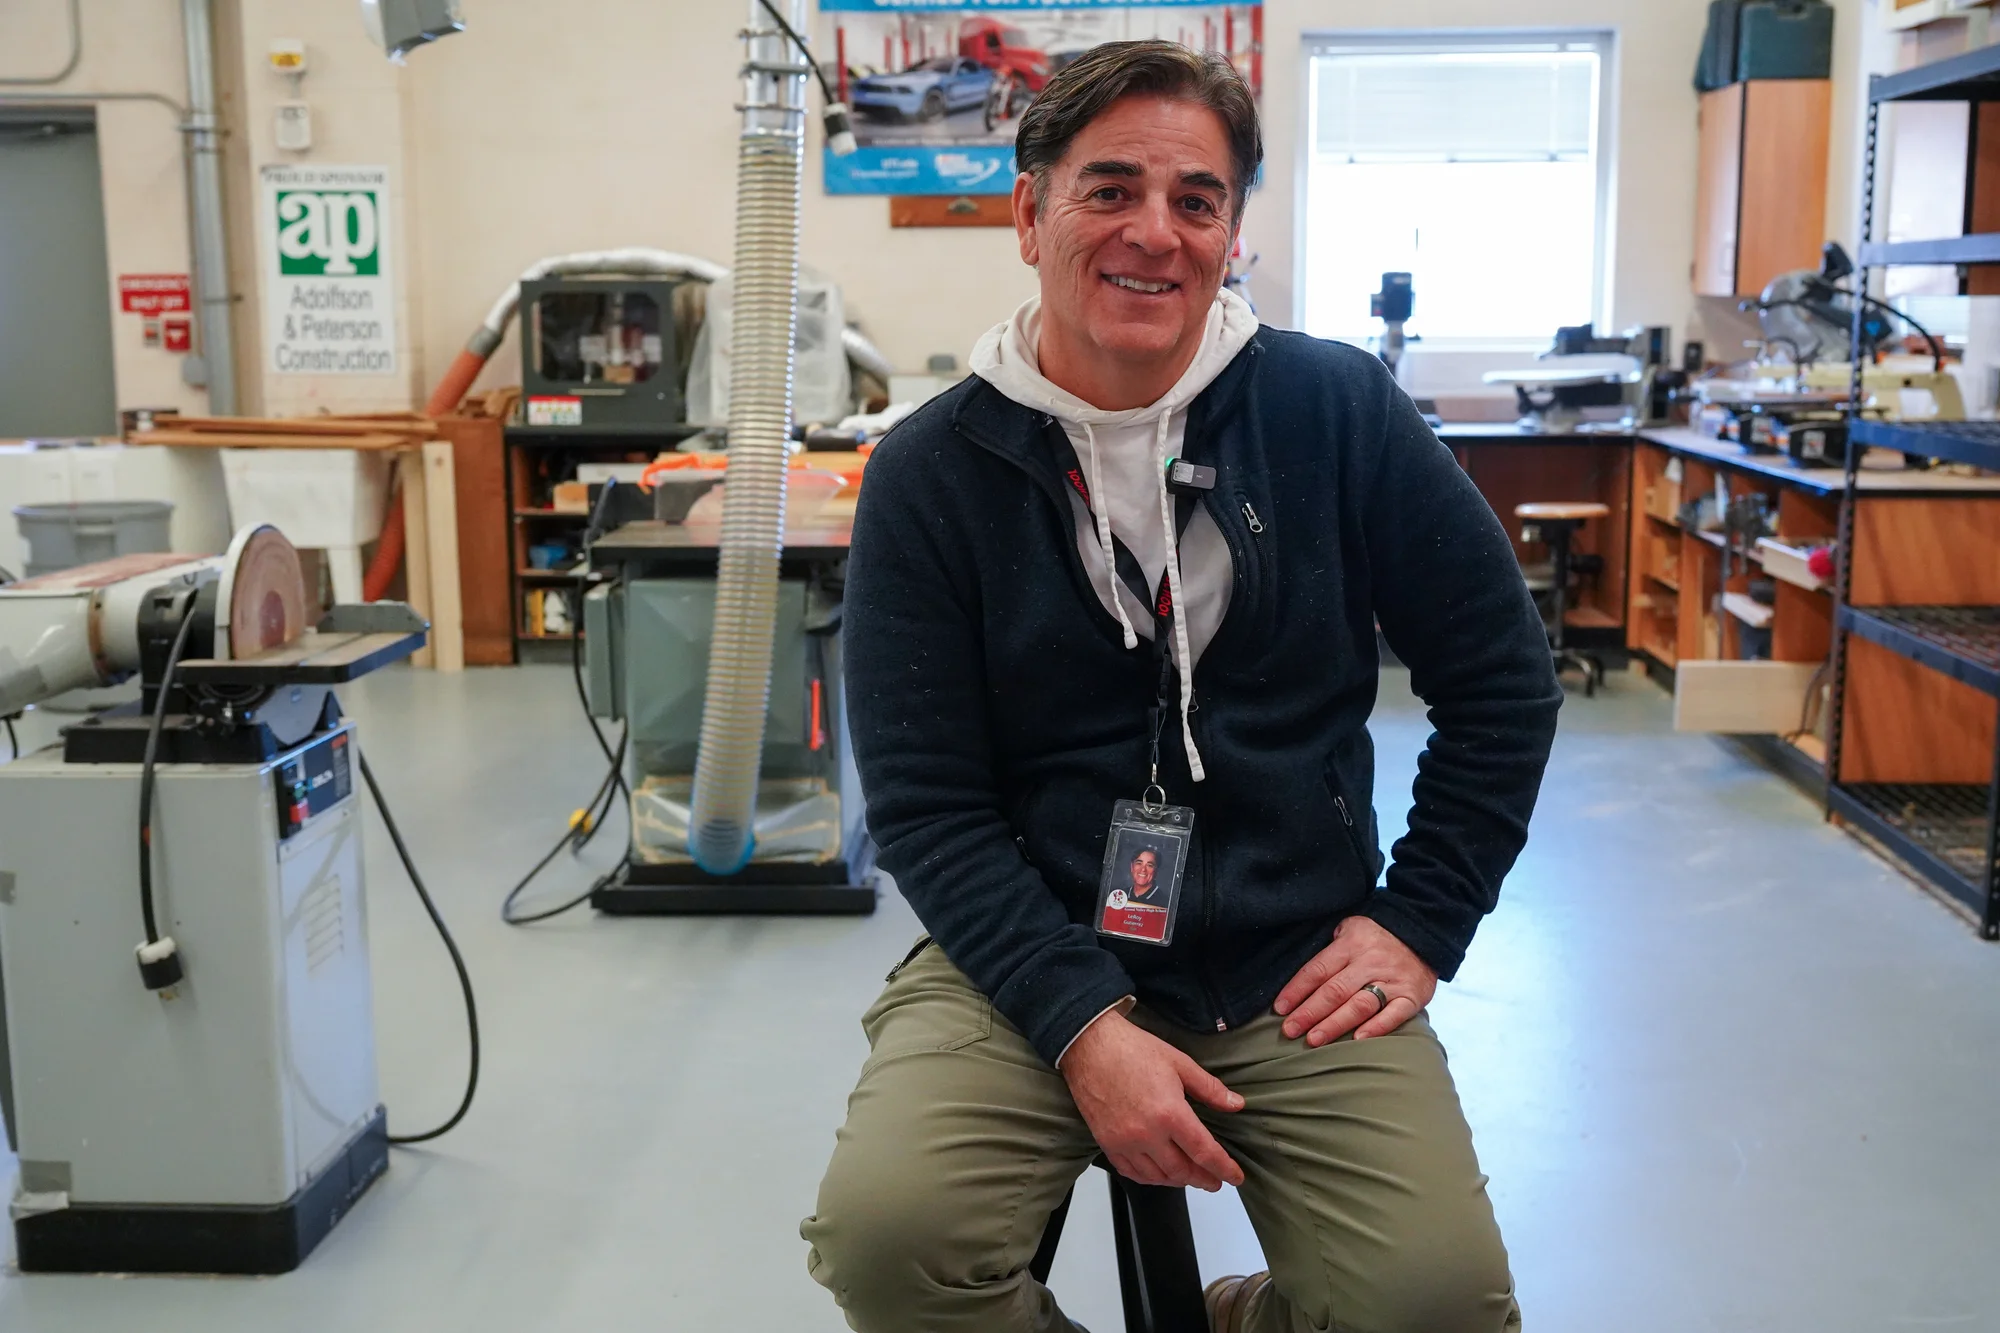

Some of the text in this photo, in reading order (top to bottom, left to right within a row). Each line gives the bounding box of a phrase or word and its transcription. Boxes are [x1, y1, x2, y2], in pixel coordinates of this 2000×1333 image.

[279, 192, 376, 275] ap
[290, 283, 374, 310] Adolfson
[283, 313, 383, 341] & Peterson
[274, 342, 392, 371] Construction
